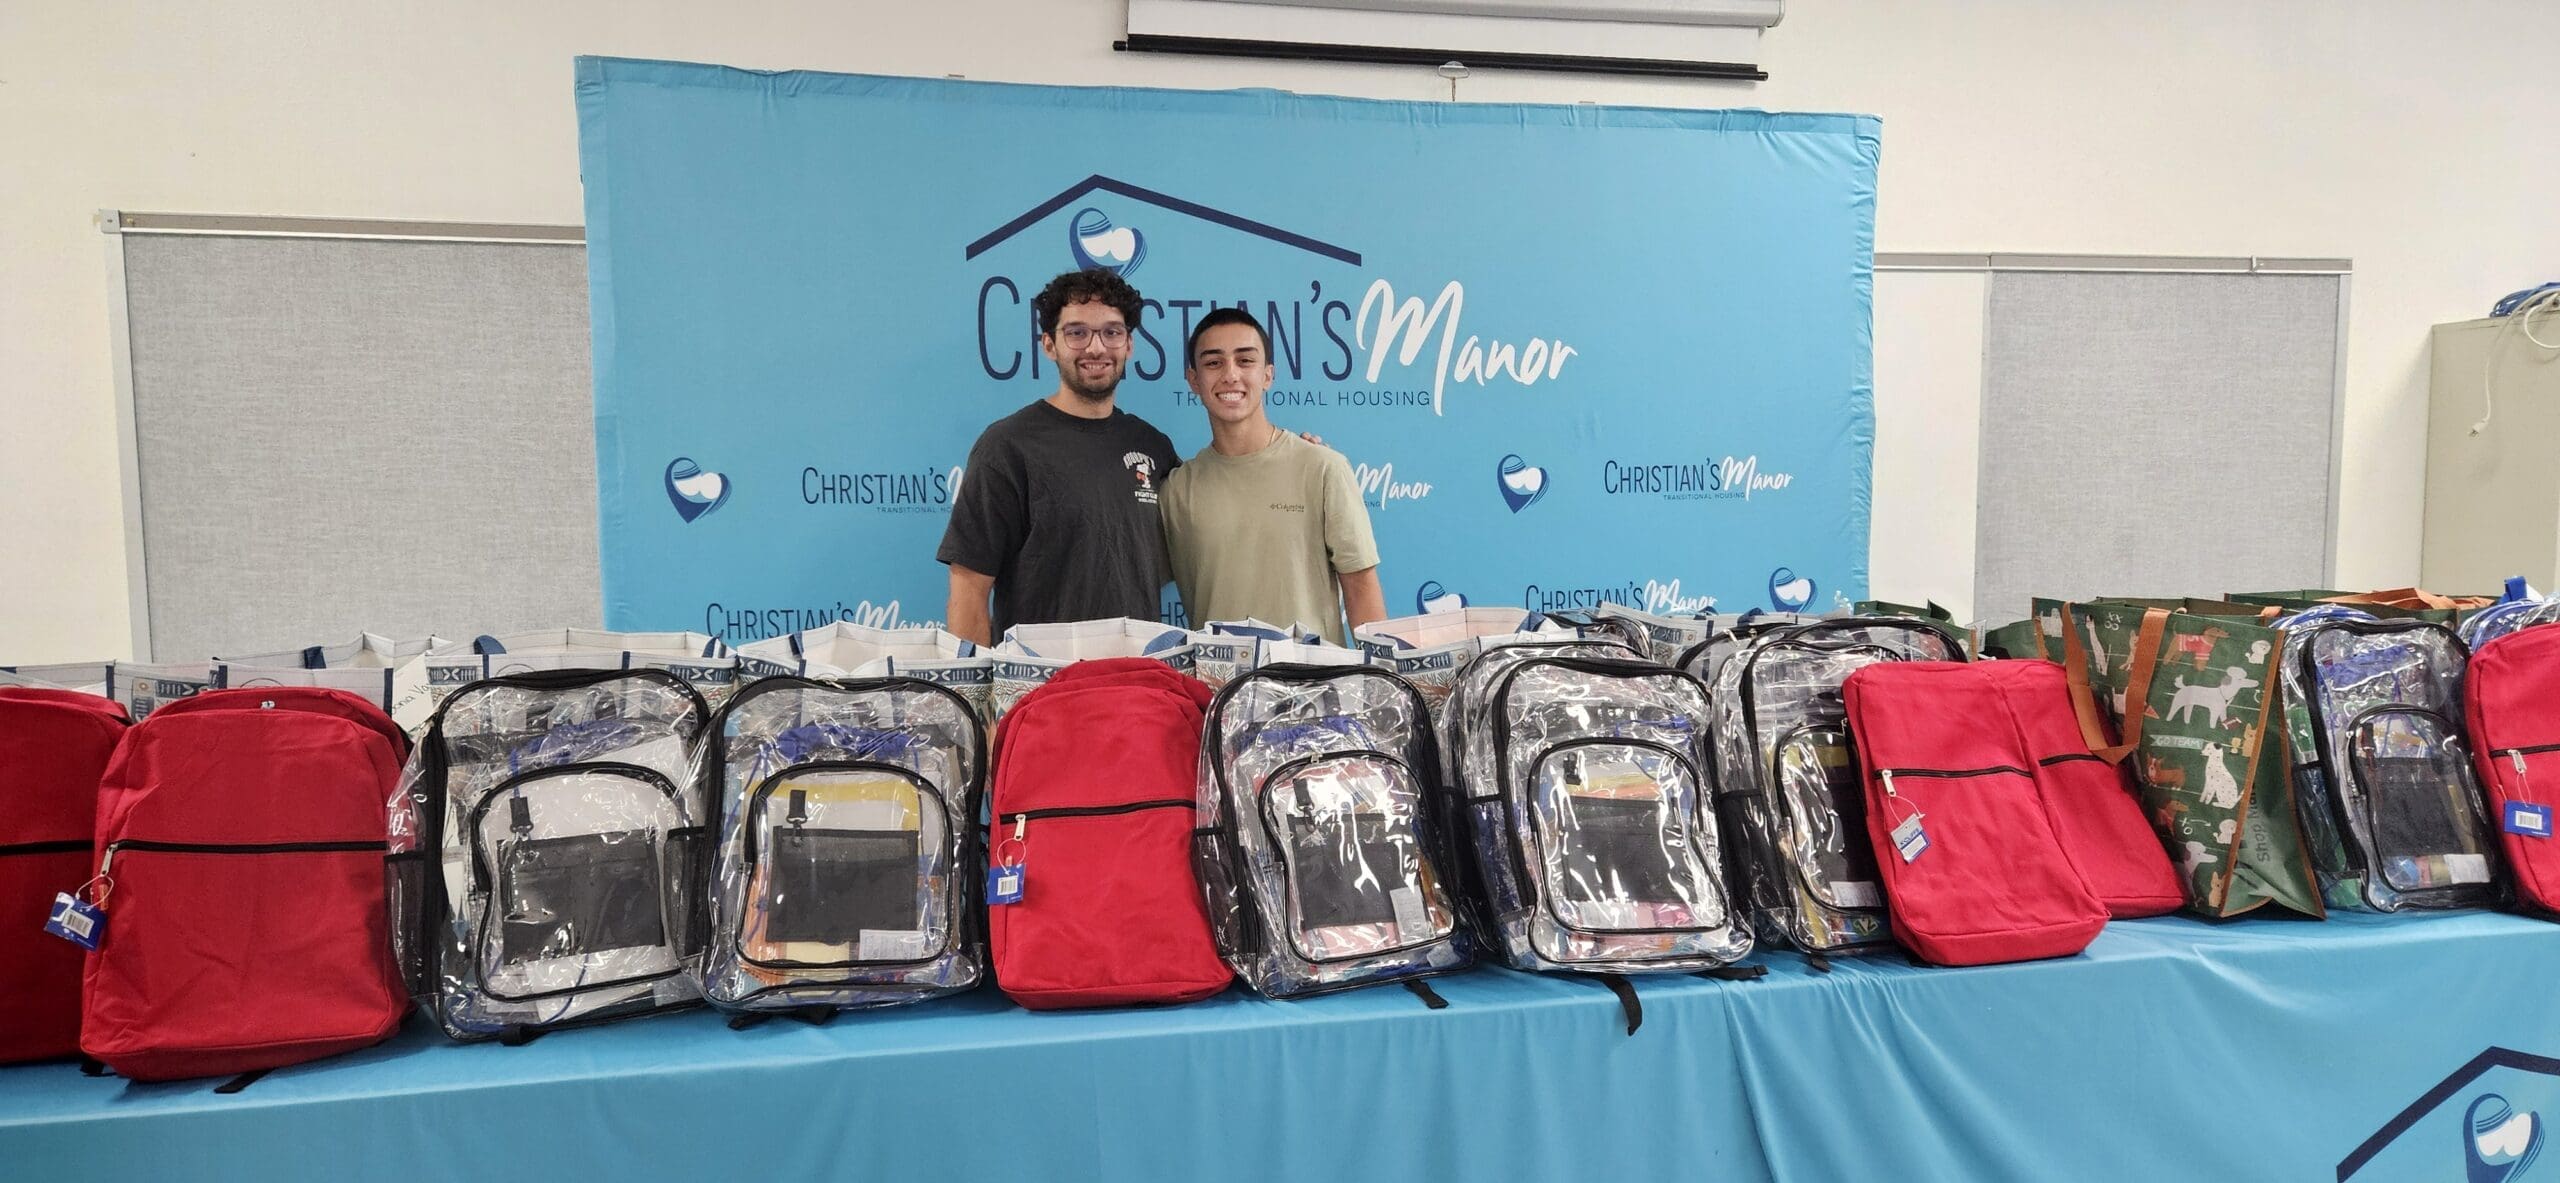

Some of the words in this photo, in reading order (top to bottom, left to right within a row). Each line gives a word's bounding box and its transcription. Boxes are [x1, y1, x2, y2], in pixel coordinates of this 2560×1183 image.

[1356, 279, 1578, 416] Manor
[1173, 390, 1328, 406] TRIONAL
[1338, 391, 1430, 406] HOUSING
[802, 467, 947, 504] CHRISTIAN'S
[1355, 462, 1433, 511] Manor
[1604, 457, 1720, 494] CHRISTIAN'S
[1720, 455, 1793, 501] Manor
